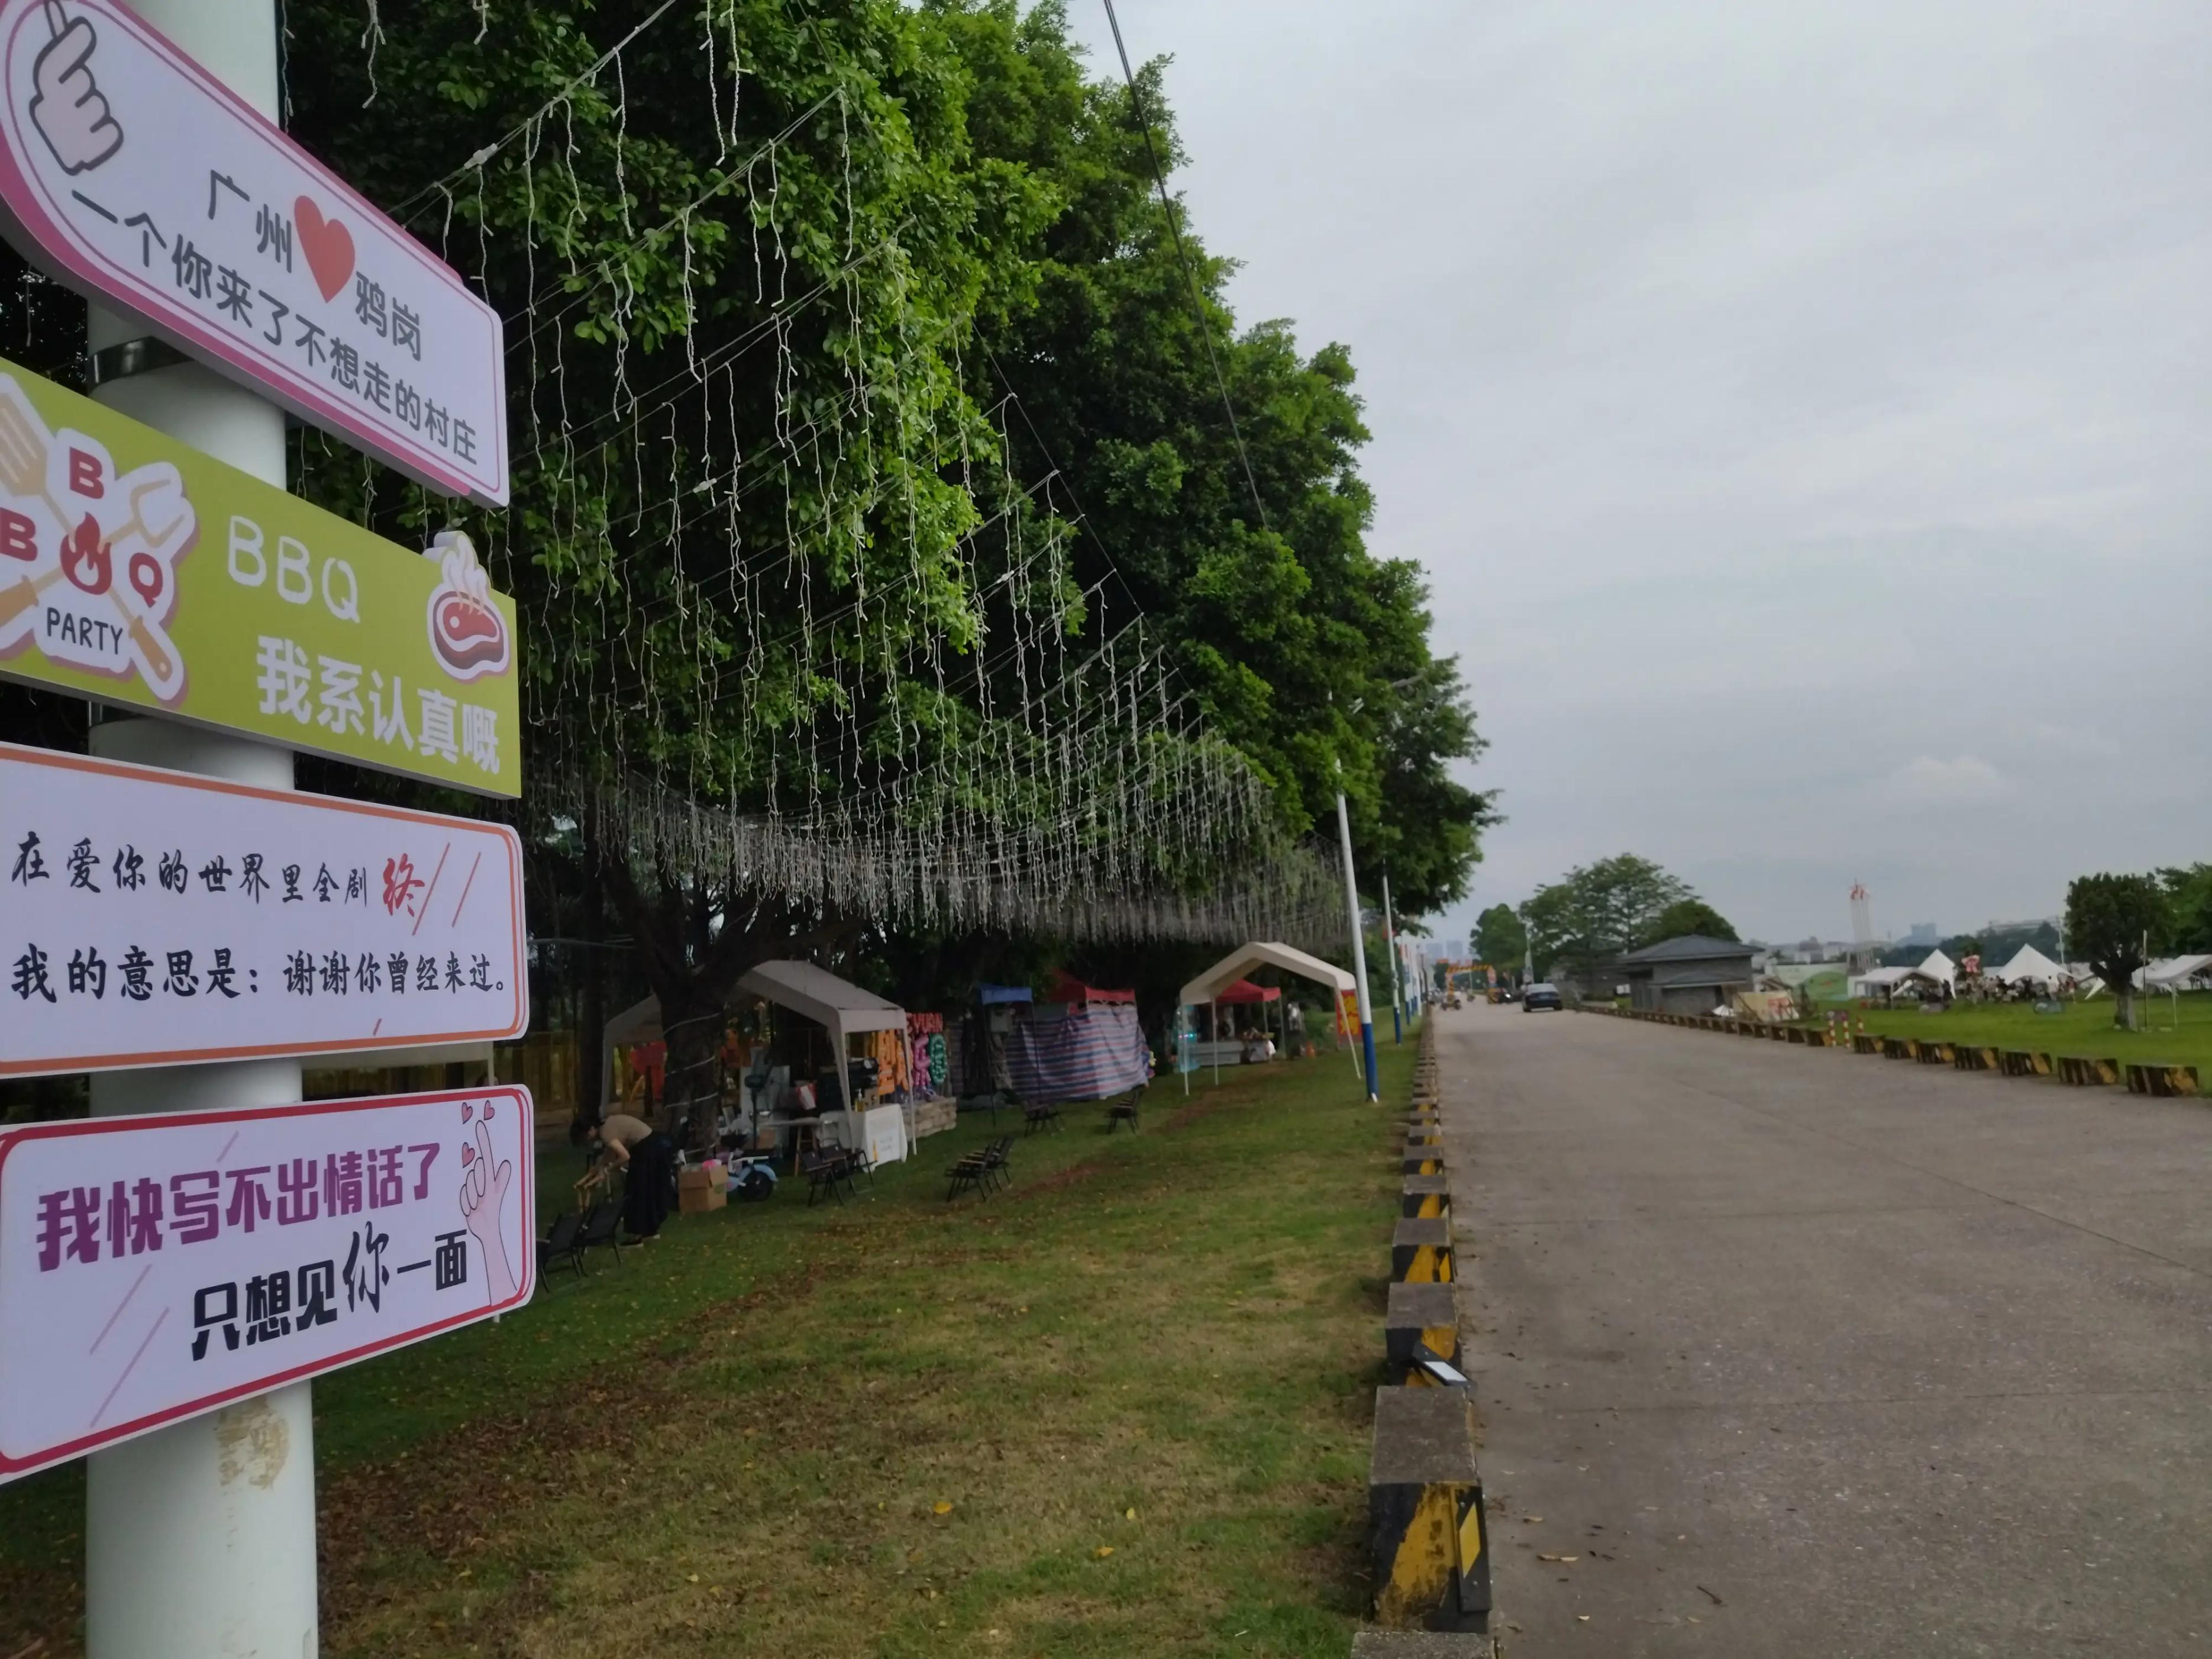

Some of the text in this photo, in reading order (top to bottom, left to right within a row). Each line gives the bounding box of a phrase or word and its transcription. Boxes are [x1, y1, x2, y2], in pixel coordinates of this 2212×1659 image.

[72, 190, 477, 466] 一个你来了不想走的村庄
[208, 169, 422, 360] 广州 鸦岗
[47, 607, 123, 655] PARTY
[228, 516, 360, 623] BBQ
[256, 635, 499, 774] 我系认真嘅
[36, 1142, 440, 1272] 我快写不出情话了
[191, 1221, 467, 1361] 只想见你一面
